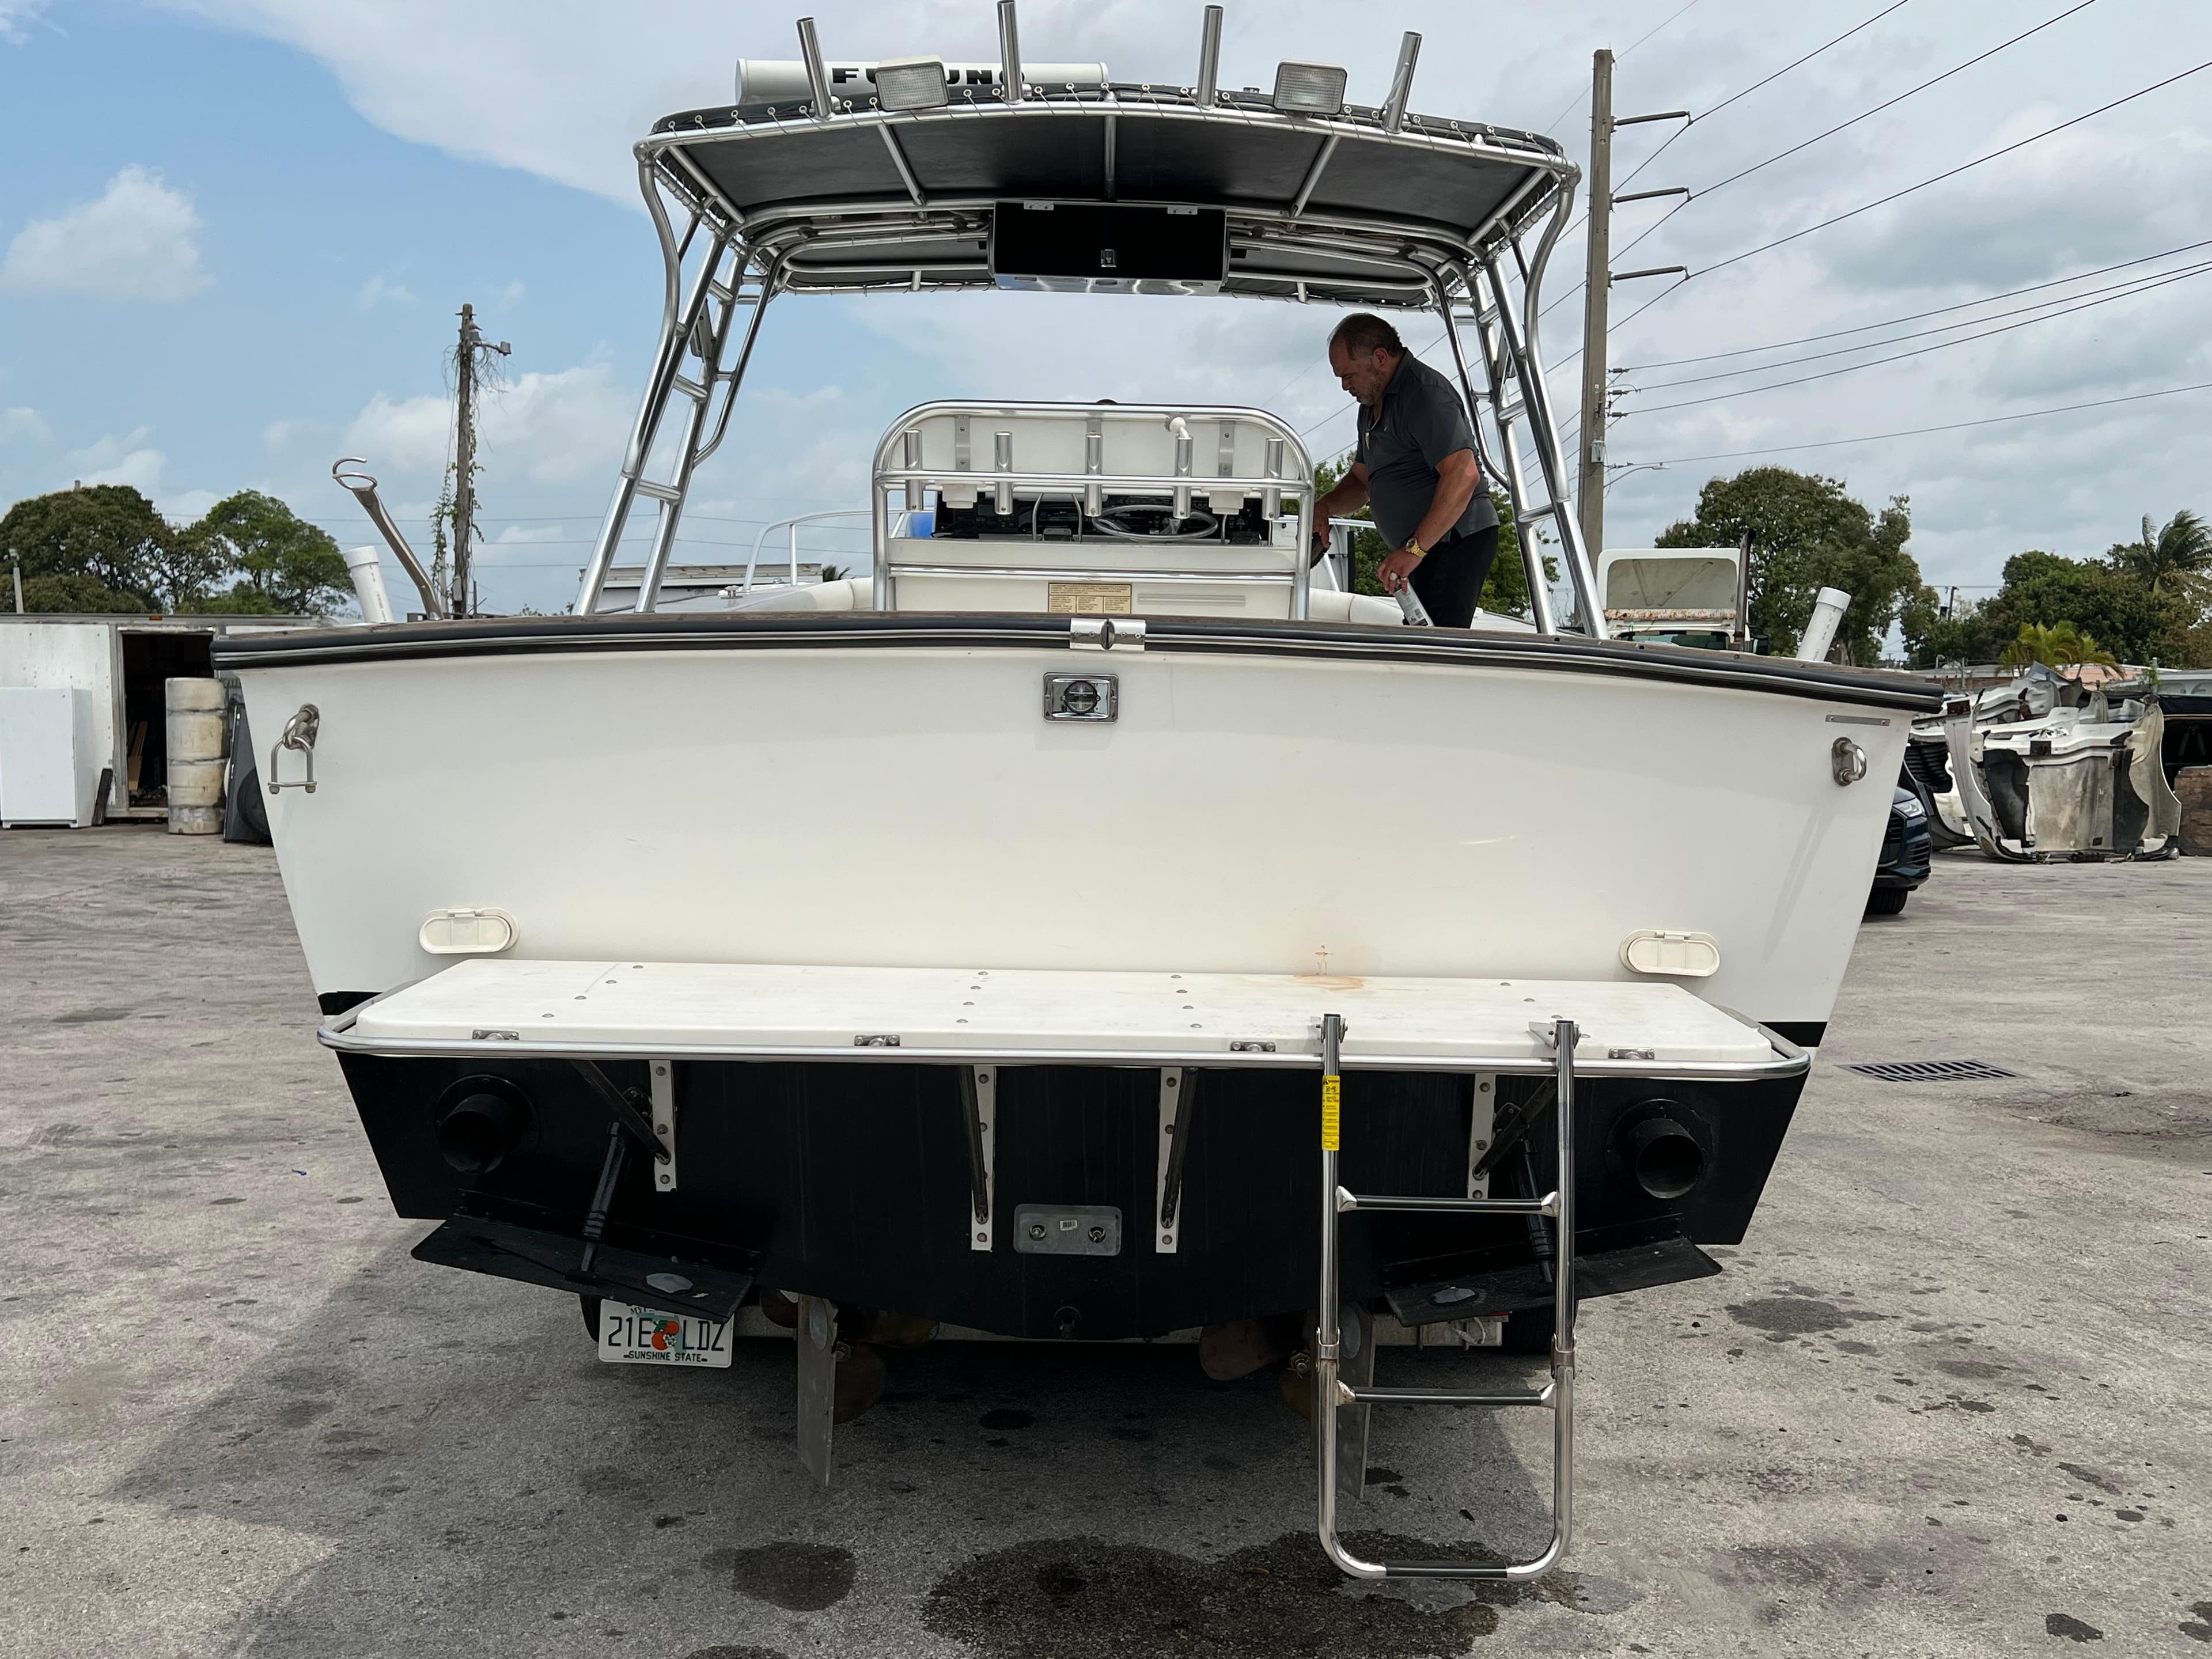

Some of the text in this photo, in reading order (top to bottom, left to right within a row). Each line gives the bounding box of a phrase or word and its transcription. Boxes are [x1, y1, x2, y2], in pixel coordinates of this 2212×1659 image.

[608, 1316, 652, 1347] 21E
[628, 1350, 702, 1362] SUNSHINE STATE
